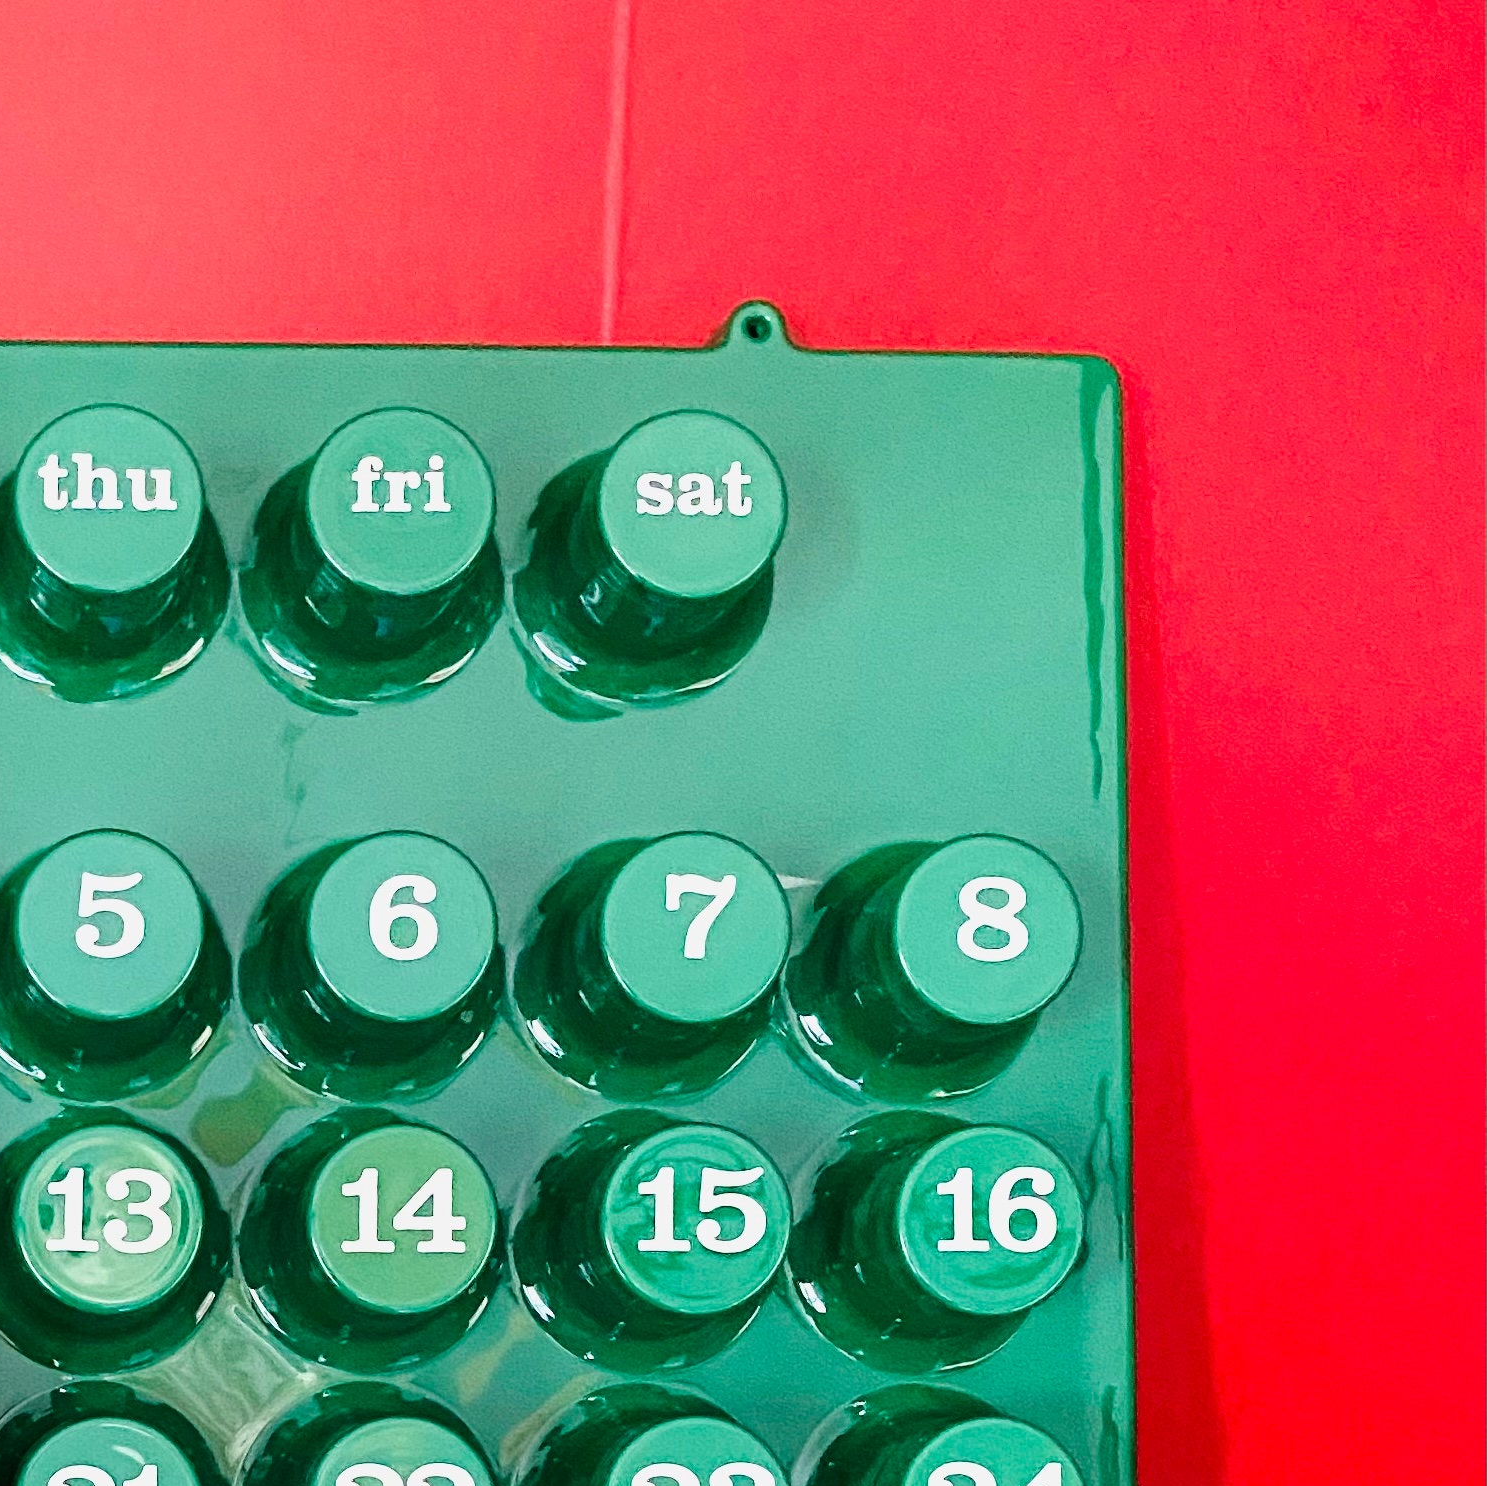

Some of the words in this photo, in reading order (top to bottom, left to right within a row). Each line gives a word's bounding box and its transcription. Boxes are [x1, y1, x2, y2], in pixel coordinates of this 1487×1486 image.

[36, 451, 179, 513] thu
[350, 454, 452, 514] fri
[635, 459, 753, 518] sat
[74, 870, 146, 960] 5
[368, 873, 439, 962] 6
[664, 872, 738, 960] 7
[956, 875, 1030, 963] 8
[44, 1166, 174, 1255] 13
[339, 1167, 468, 1254] 14
[636, 1165, 768, 1255] 15
[935, 1165, 1058, 1254] 16
